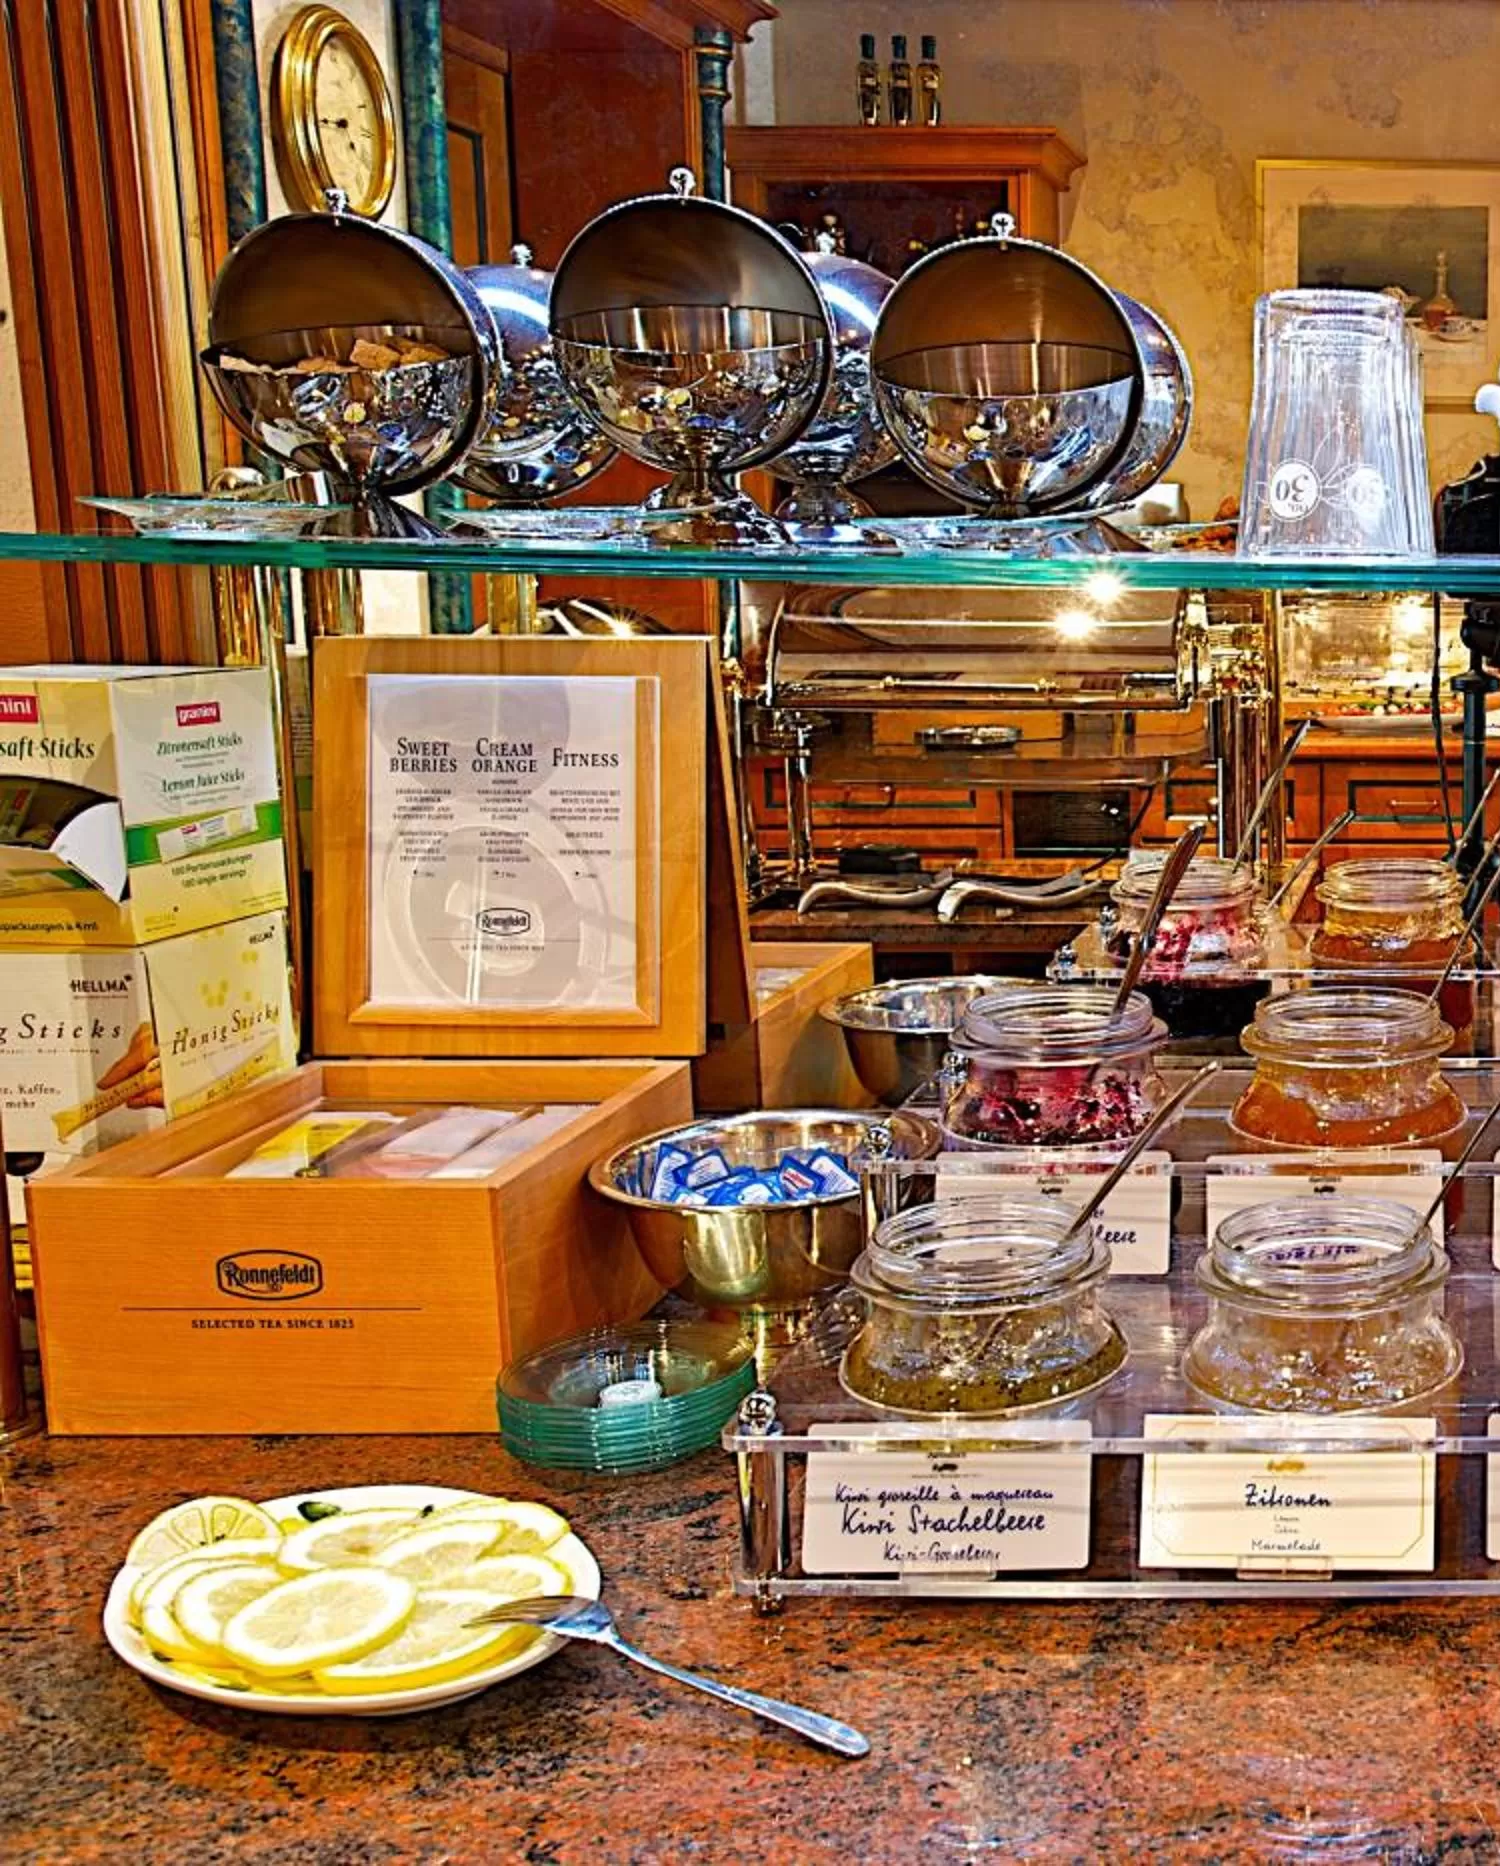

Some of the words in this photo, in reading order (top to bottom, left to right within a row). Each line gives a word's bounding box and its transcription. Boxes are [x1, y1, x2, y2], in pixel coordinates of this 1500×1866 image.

[40, 736, 95, 759] Sticks
[390, 757, 457, 773] BERRIES
[472, 758, 538, 773] ORANGE
[70, 979, 129, 993] HELLMA
[18, 1013, 122, 1039] Sticks
[172, 1026, 227, 1057] Honig
[223, 1261, 315, 1288] Ronnefeldt
[191, 1319, 255, 1329] SELECTED
[259, 1319, 281, 1329] TEA
[287, 1319, 324, 1329] SINCE
[1245, 1483, 1332, 1508] Zitronen
[842, 1503, 895, 1534] Kiwi
[908, 1503, 1045, 1534] Stachelbeere
